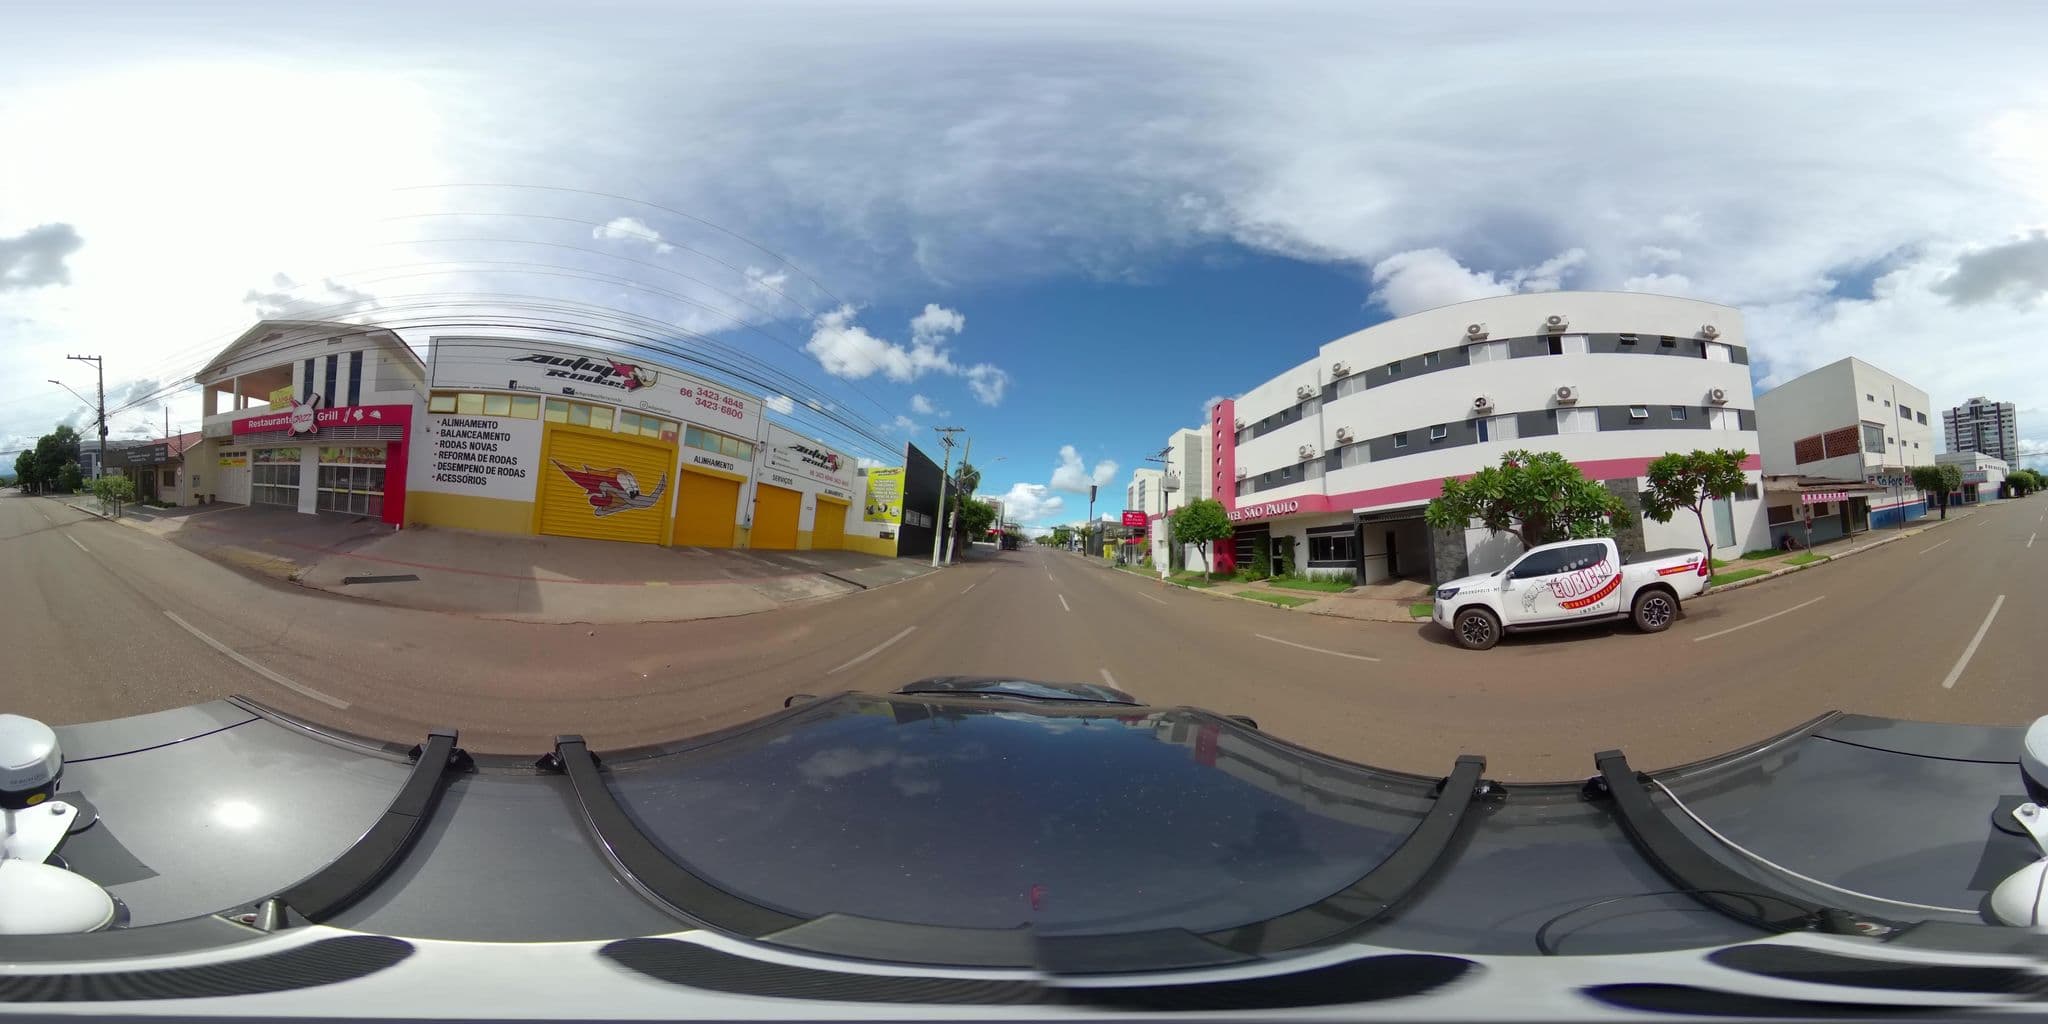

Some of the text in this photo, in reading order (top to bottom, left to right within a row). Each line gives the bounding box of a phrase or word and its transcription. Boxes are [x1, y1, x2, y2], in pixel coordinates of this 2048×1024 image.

[680, 387, 744, 409] 66 3423-4848
[695, 397, 743, 419] 3423-6800
[317, 410, 338, 421] Grill
[441, 418, 498, 430] ALINHAMENTO
[440, 429, 511, 441] BALANCEAMENTO
[440, 440, 498, 452] RODAS NOVAS
[438, 451, 518, 465] REFORMA DE RODAS
[694, 455, 734, 471] ALINHAMENTO
[437, 462, 526, 478] DESEMPENO DE RODAS
[436, 473, 487, 485] ACESSÓRIOS
[772, 474, 793, 486] SERVIÇOS
[1266, 500, 1298, 515] PAULO
